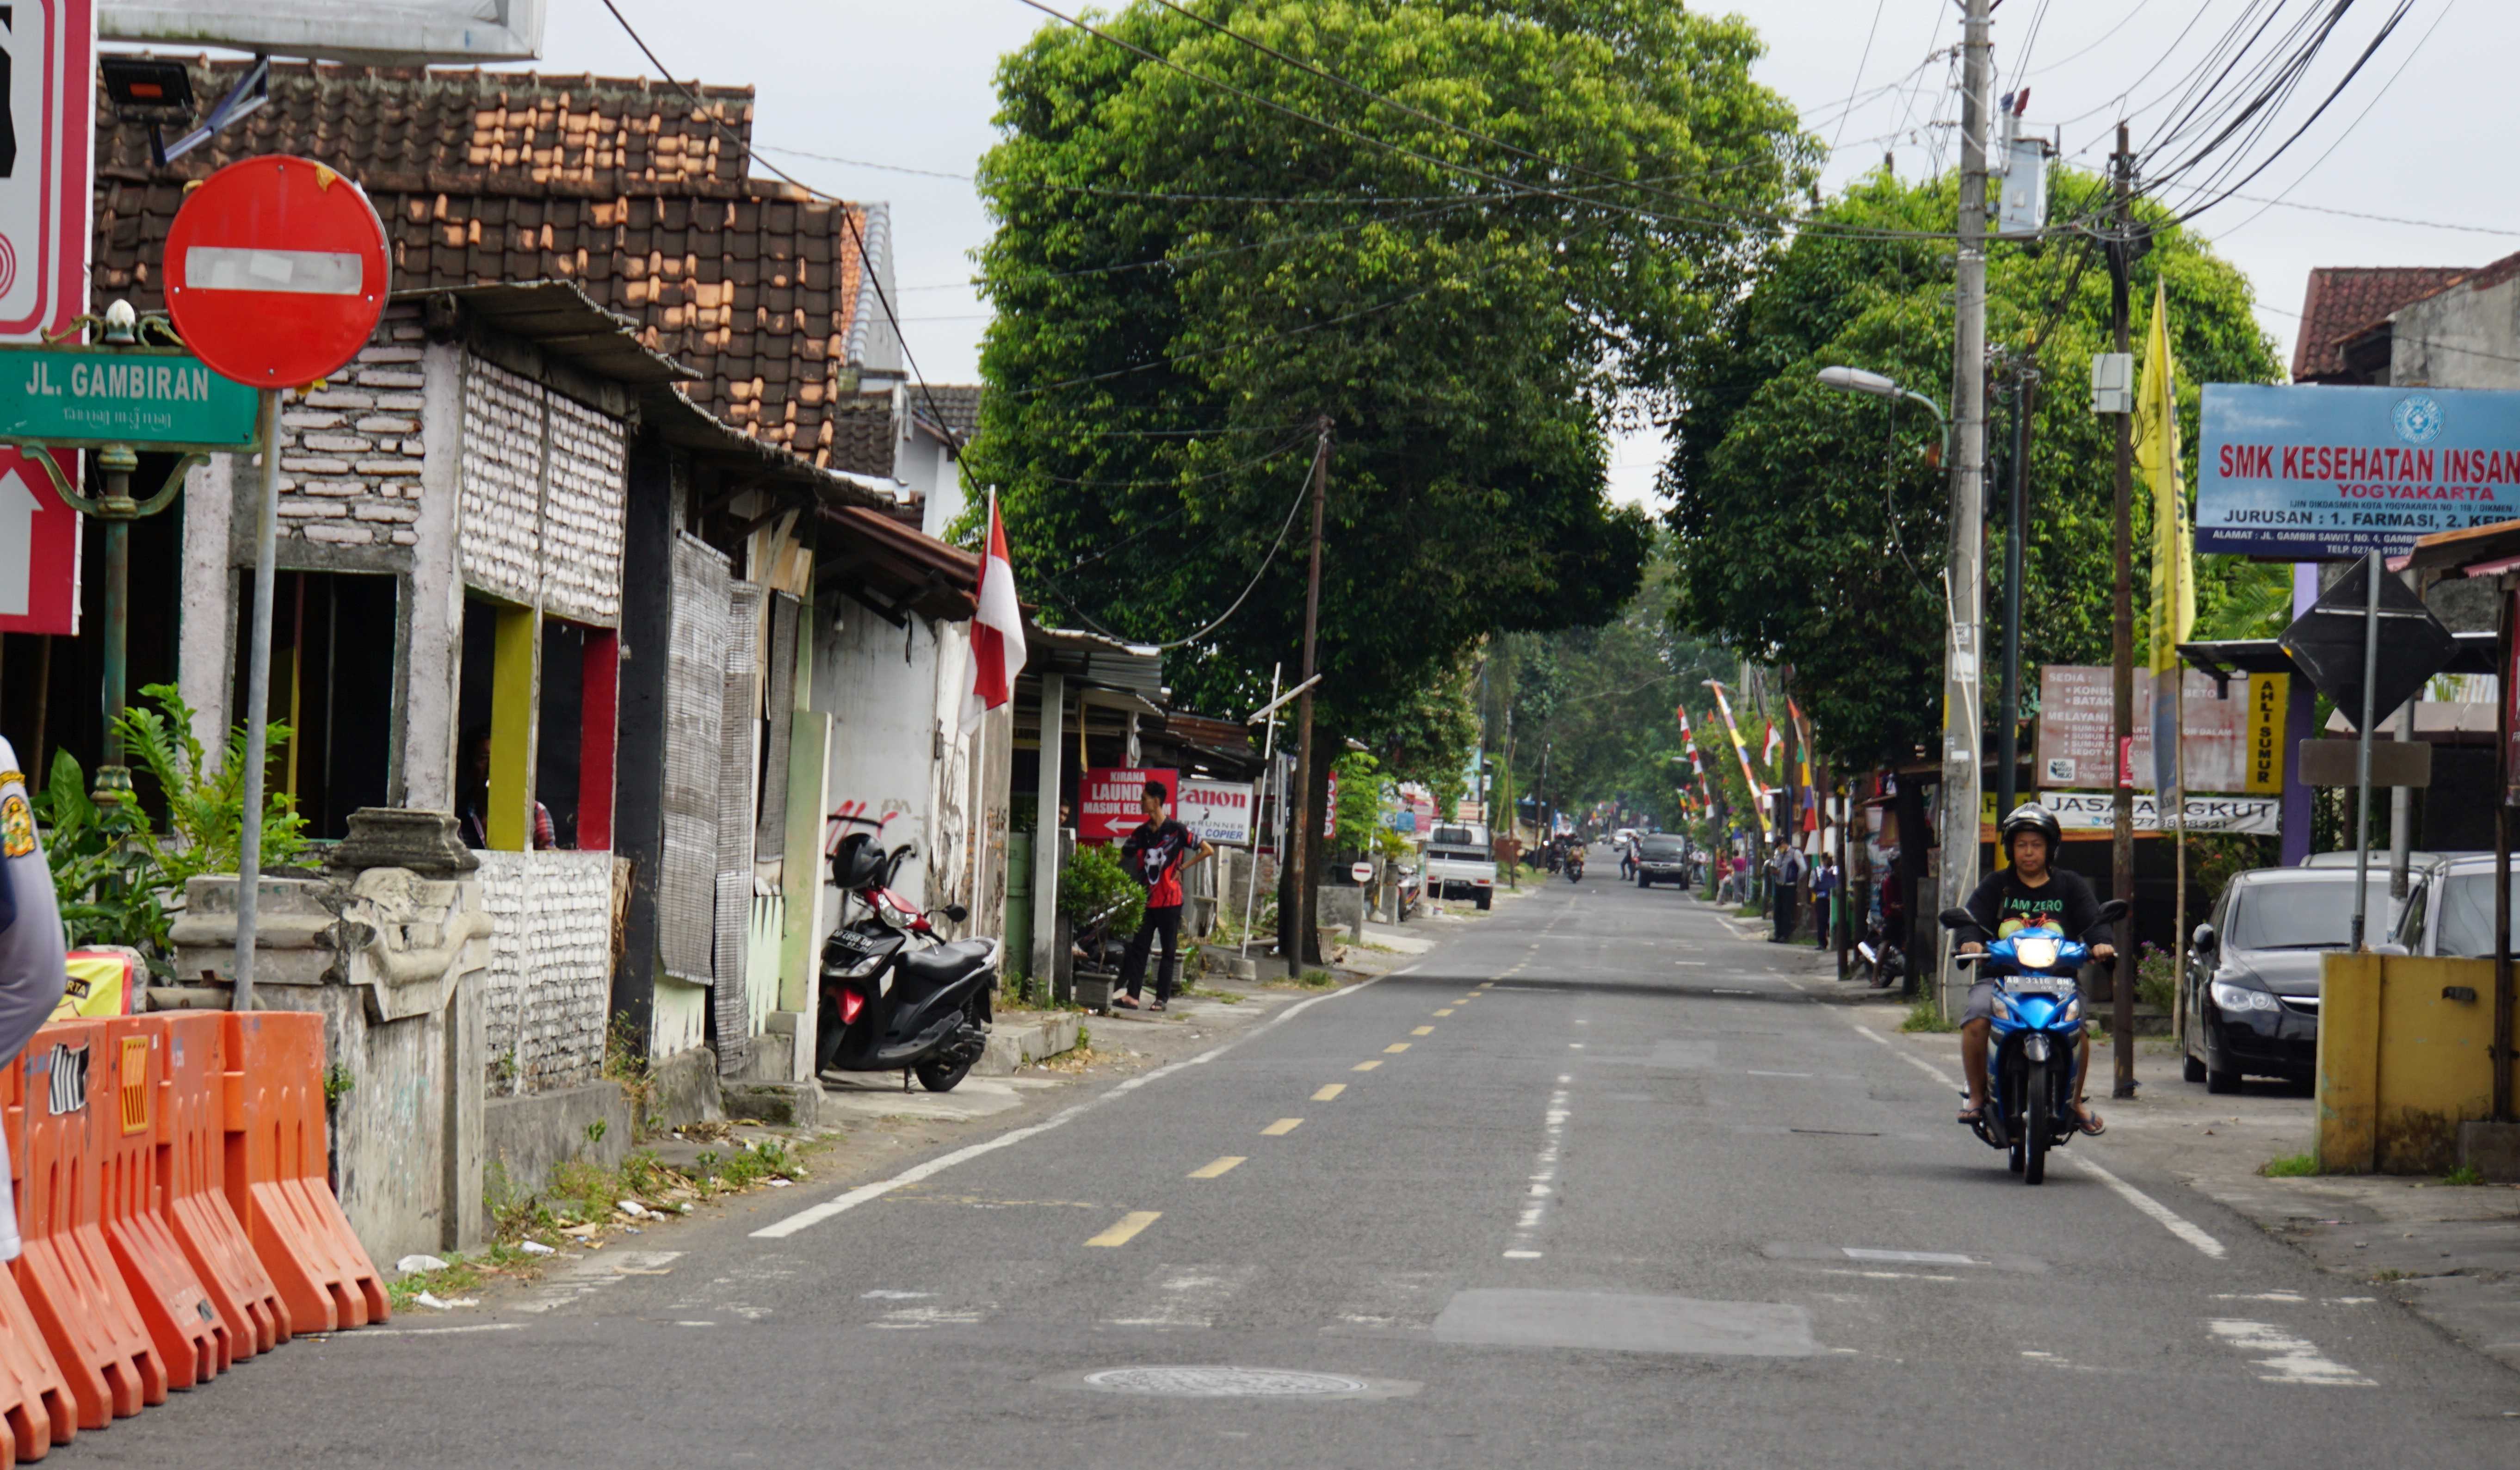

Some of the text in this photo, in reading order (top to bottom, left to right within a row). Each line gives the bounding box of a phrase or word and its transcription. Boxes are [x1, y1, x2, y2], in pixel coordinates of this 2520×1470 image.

[26, 361, 209, 401] JL. GAMBIRAN
[2219, 444, 2520, 484] SMK KESEHATAN INSAN
[2338, 483, 2495, 501] YOGYAKARTA
[2361, 501, 2381, 509] KOTA
[2385, 502, 2437, 511] YOGYAKARTA
[2224, 509, 2312, 525] JURUSAN
[2319, 514, 2323, 525] :
[2330, 512, 2346, 525] 1.
[2352, 512, 2440, 530] FARMASI,
[2446, 514, 2462, 528] 2.
[2212, 530, 2254, 539] ALAMAT
[2261, 531, 2274, 540] JL.
[2277, 532, 2316, 542] GAMBIR
[2318, 532, 2350, 543] SAWIT,
[2049, 673, 2084, 682] SEDIA
[2183, 688, 2217, 698] BETO
[2048, 711, 2109, 722] MELAYANI
[2257, 680, 2273, 783] AHLI SUMUR
[1111, 771, 1146, 783] KIRANA
[1092, 783, 1144, 801] LAUND
[1083, 802, 1121, 815] MASUK
[2137, 800, 2273, 818] AGKUT
[1205, 828, 1244, 840] COPIER
[2003, 896, 2063, 912] I AM ZERO
